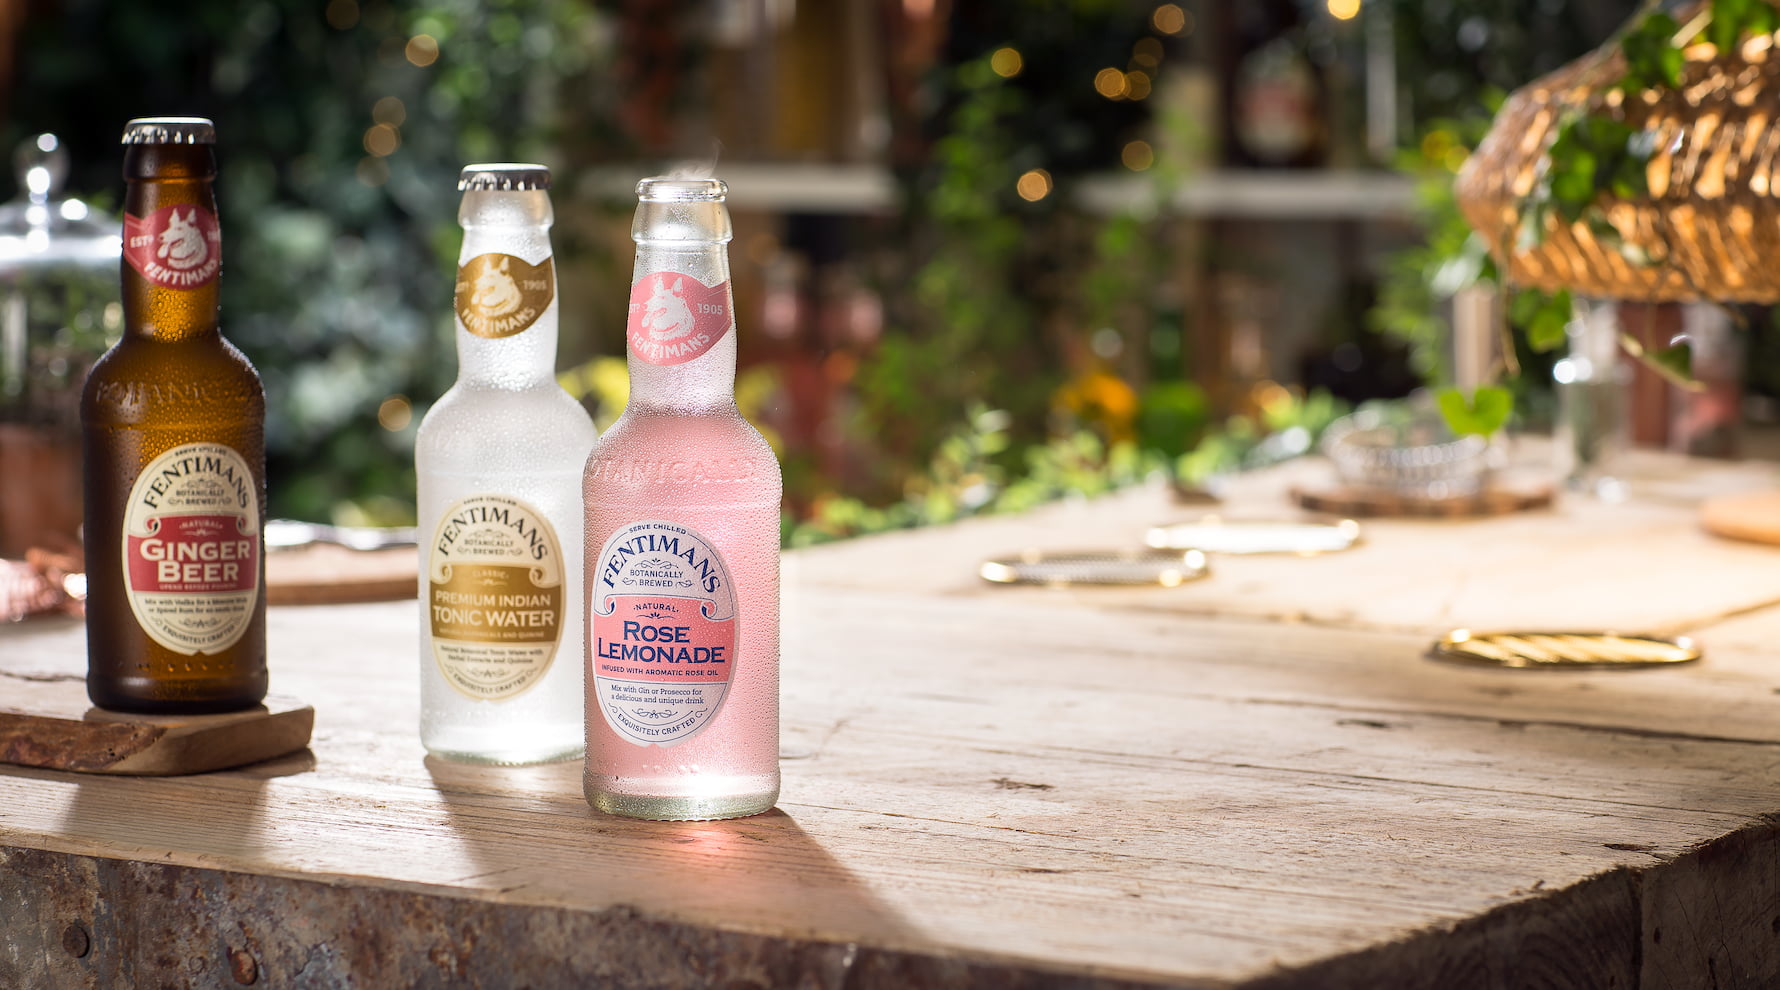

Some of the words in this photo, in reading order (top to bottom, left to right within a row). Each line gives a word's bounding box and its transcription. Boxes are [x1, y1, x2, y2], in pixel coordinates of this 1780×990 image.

[144, 258, 217, 286] FENTIMANS
[697, 303, 723, 316] 1905
[461, 306, 536, 333] FENTIMANS
[631, 331, 711, 359] FENTIMANS
[143, 456, 249, 510] FENTIMANS
[176, 489, 225, 497] BOTANICALLY
[182, 520, 219, 529] NATURAL
[438, 506, 548, 561] FENTIMANS
[629, 524, 651, 533] SERVE
[654, 524, 687, 535] CHILLED
[139, 538, 251, 561] GINGER
[464, 539, 514, 547] BOTANICALLY
[157, 560, 240, 583] BEER
[602, 534, 721, 593] FENTIMANS
[630, 569, 684, 578] BOTANICALLY
[640, 579, 674, 588] BREWED
[435, 590, 496, 606] PREMIUM
[499, 594, 551, 607] INDIAN
[635, 603, 676, 612] NATURAL
[433, 605, 482, 626] TONIC
[485, 609, 555, 627] WATER
[162, 625, 206, 644] EXQUISITELY
[207, 625, 235, 643] CRAFTED
[623, 620, 691, 643] ROSE
[598, 637, 725, 664] LEMONADE
[602, 664, 624, 673] INFUSED
[495, 675, 526, 693] CRAFTED
[623, 686, 637, 694] with
[638, 686, 650, 695] Gin
[660, 688, 690, 696] Prosecco
[692, 688, 702, 696] for
[616, 693, 642, 703] delicious
[644, 696, 657, 704] and
[658, 697, 684, 706] unique
[685, 697, 704, 705] drink
[617, 713, 660, 736] EXQUISITELY
[662, 717, 696, 735] CRAFTED
